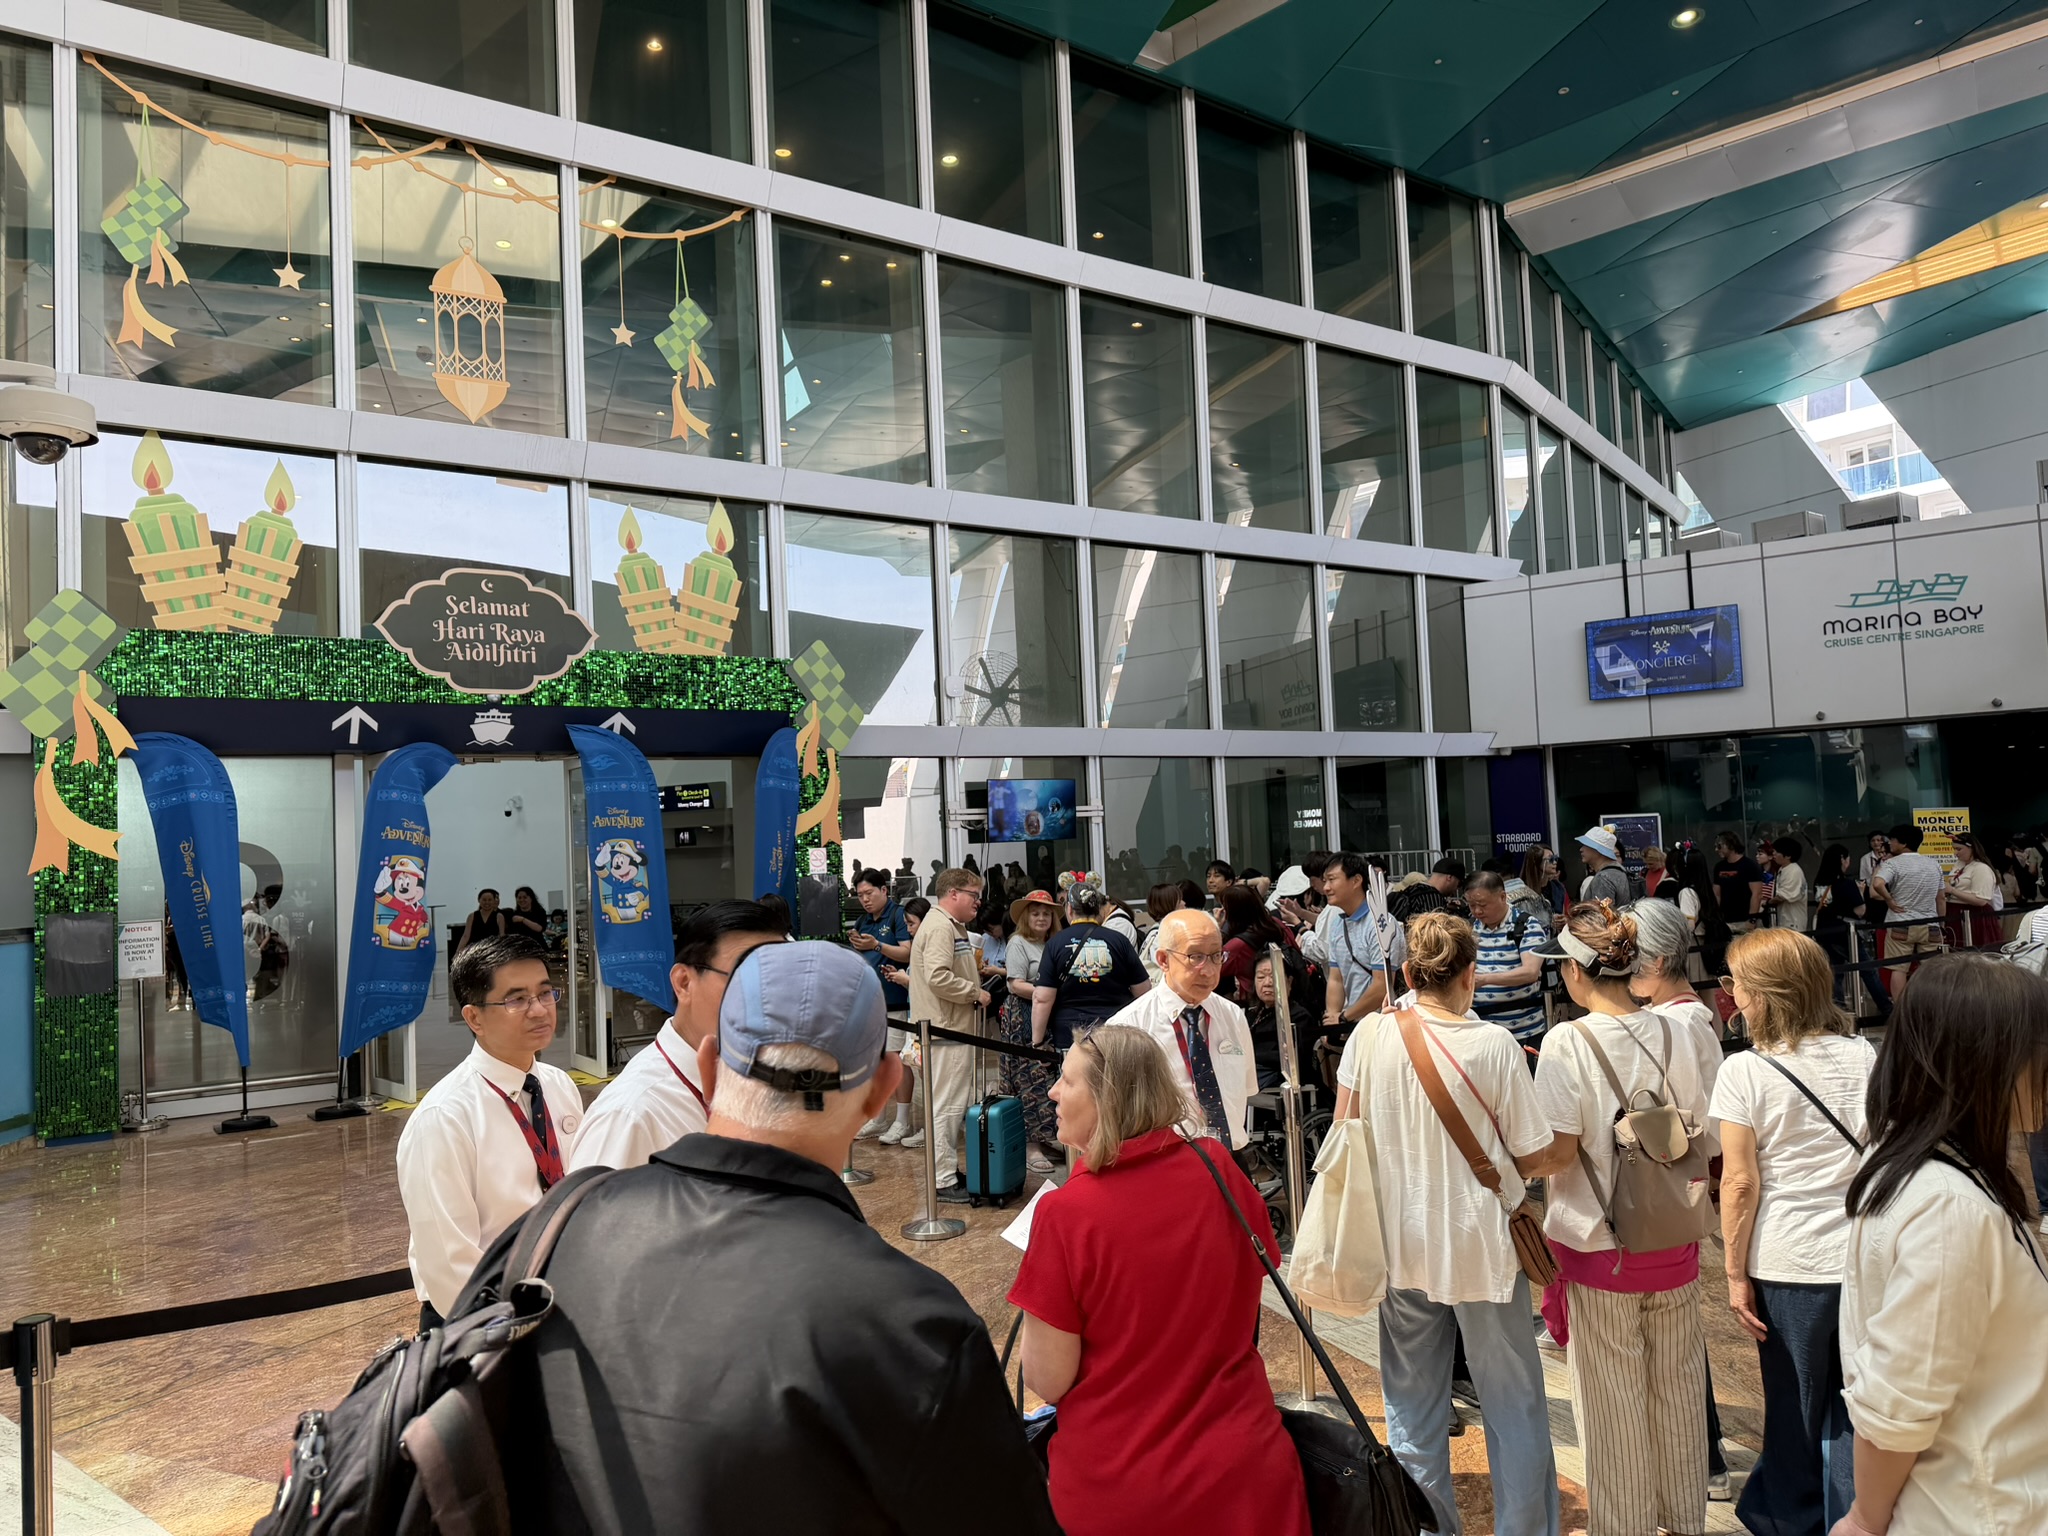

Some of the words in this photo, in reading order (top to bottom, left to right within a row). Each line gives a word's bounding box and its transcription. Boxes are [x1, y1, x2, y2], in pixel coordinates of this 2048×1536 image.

[445, 595, 531, 618] Selamat
[1933, 604, 1983, 624] BAY
[432, 616, 485, 642] Hari
[490, 622, 546, 647] Raya
[1824, 636, 1864, 648] CRUISE
[1866, 631, 1912, 644] CENTRE
[1914, 624, 1985, 639] SINGAPORE
[443, 641, 537, 667] Aidilfitri
[1625, 654, 1699, 670] CONCIERGE
[605, 806, 629, 815] Disney
[401, 818, 425, 831] Disney
[592, 815, 645, 828] ADVENTURE
[1917, 816, 1964, 824] MONEY
[381, 825, 430, 848] ADVENTUR
[1496, 832, 1542, 843] STARBOARD
[179, 836, 195, 878] Disney
[190, 880, 209, 919] CRUISE
[200, 924, 214, 949] LINE
[118, 936, 160, 944] INFORMATION
